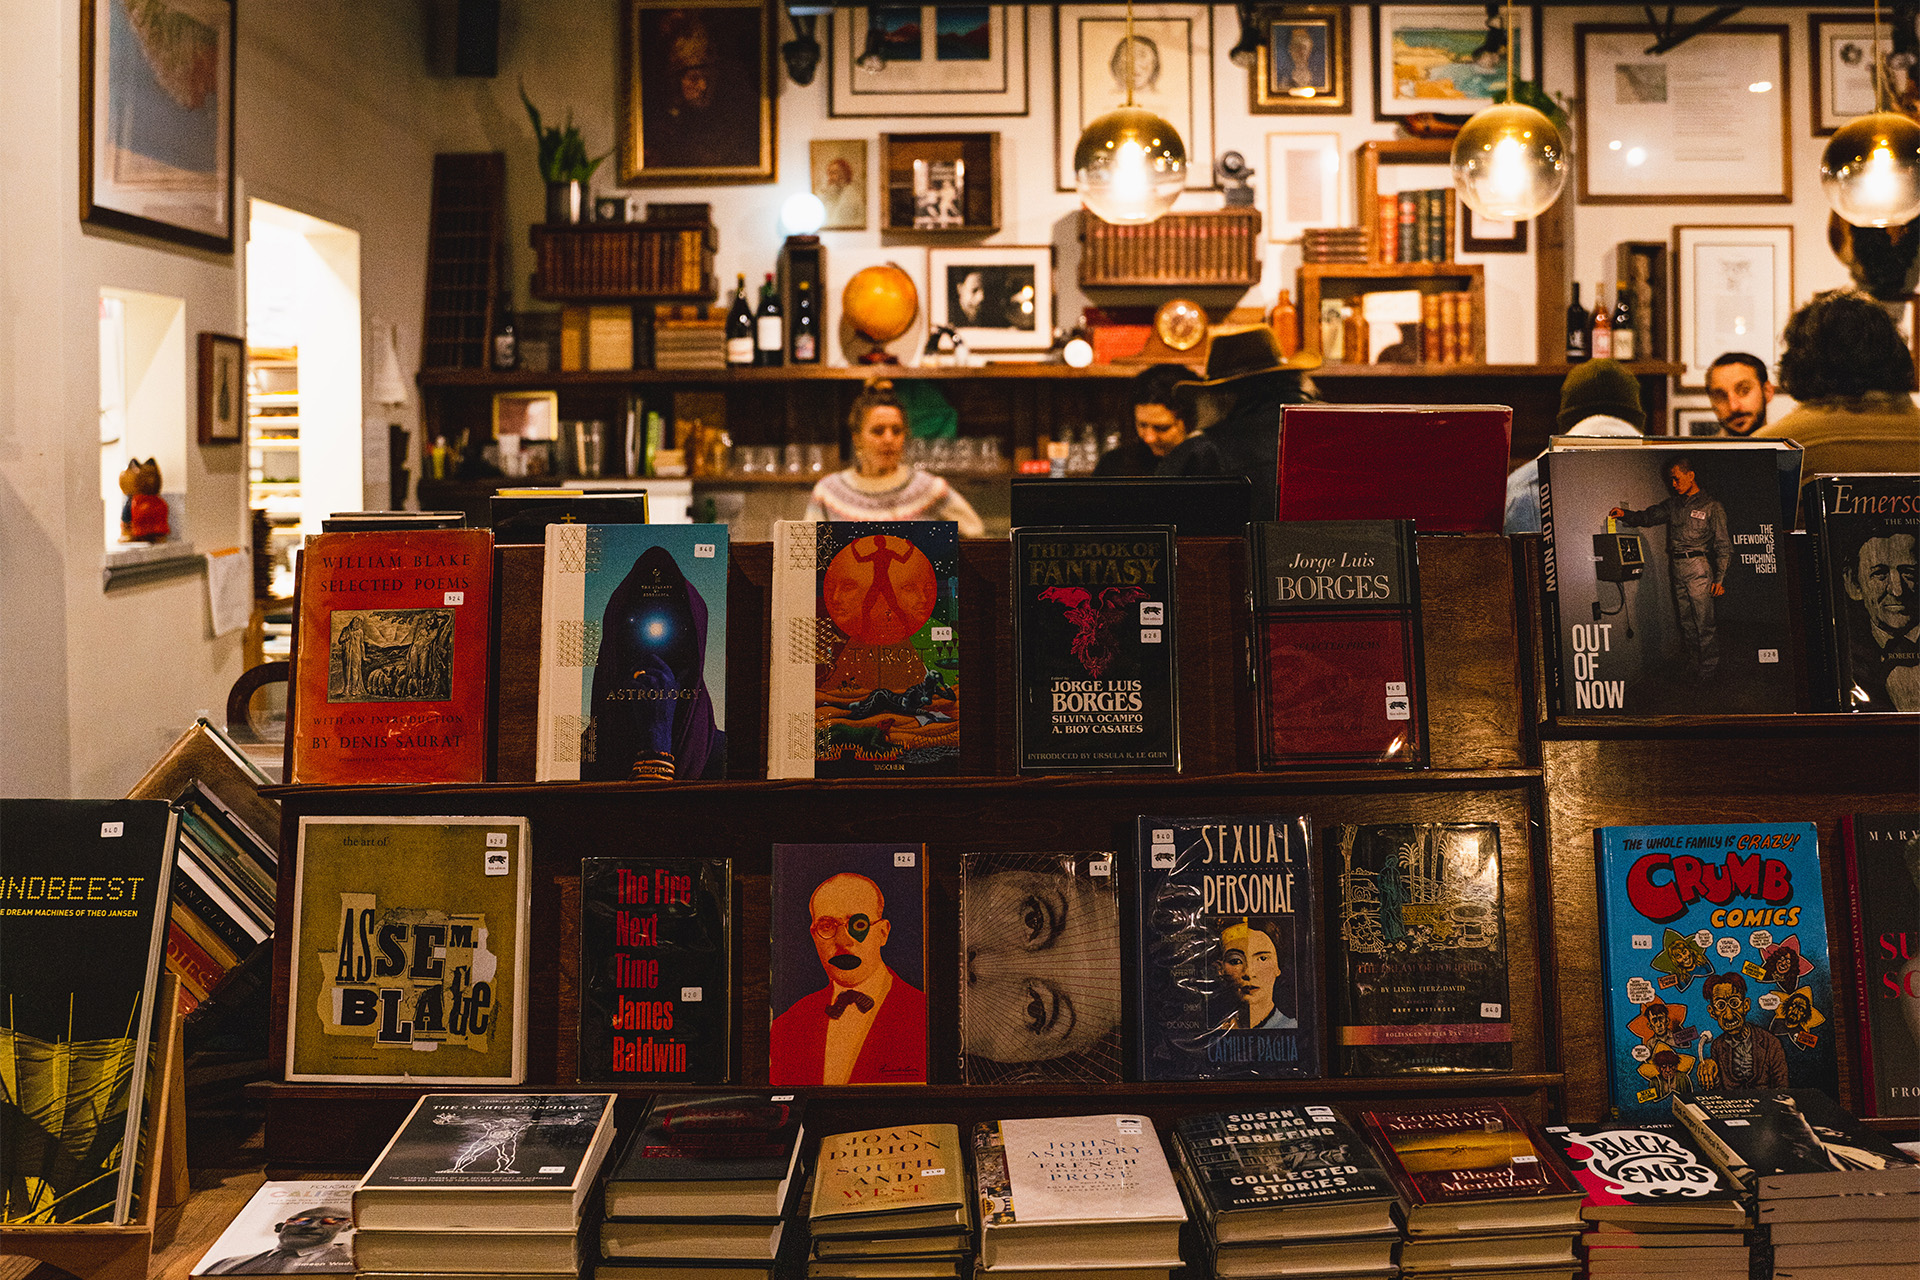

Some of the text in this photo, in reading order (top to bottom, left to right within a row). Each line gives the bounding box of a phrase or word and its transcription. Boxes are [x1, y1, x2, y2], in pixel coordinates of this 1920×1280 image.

[1538, 482, 1553, 519] OUT
[1540, 521, 1555, 545] OF
[1759, 524, 1773, 534] THE
[1733, 534, 1775, 545] LIFEWORKS
[1028, 542, 1161, 558] THE BOOK OF
[1765, 544, 1775, 554] OF
[322, 553, 471, 569] WILLIAM BLAKE
[1289, 552, 1375, 574] Jorge Luis
[1740, 554, 1776, 564] TEHCHING
[1028, 558, 1161, 586] FANTASY
[1543, 546, 1557, 593] NOW
[1755, 564, 1777, 574] HSIEH
[320, 577, 469, 592] SELECTED POEMS
[1275, 575, 1390, 600] BORGES
[1572, 624, 1612, 652] OUT
[1574, 652, 1599, 681] OF
[606, 689, 702, 700] ASTROLOGY
[1051, 680, 1142, 693] JORGE LUIS
[1575, 680, 1625, 709] NOW
[1051, 692, 1143, 713] BORGES
[313, 714, 463, 725] WITH AN INTRODUCTION
[1052, 713, 1143, 724] SILVINA OCAMPO
[1052, 724, 1144, 734] A. BIOY CASARES
[312, 735, 463, 749] BY DENIS SAURAT
[1028, 752, 1079, 760] INTRODUCED
[1093, 752, 1125, 760] URSULA
[1148, 751, 1168, 759] GUIN
[104, 826, 118, 834] $40
[343, 836, 389, 847] the art of
[1202, 824, 1293, 864] SEXUAL
[1623, 833, 1801, 852] THE WHOLE FAMILY IS CRAZY!
[617, 868, 691, 905] The Fire
[1626, 851, 1794, 924] CRUMB
[6, 908, 138, 917] DREAM MACHINES OF THEO JANSEN
[1710, 907, 1802, 928] COMICS
[616, 910, 659, 947] Next
[615, 953, 660, 989] Time
[1381, 985, 1390, 993] BY
[612, 995, 674, 1030] James
[612, 1036, 687, 1073] Baldwin
[1208, 1035, 1299, 1063] CAMILLE PAGLIA
[1228, 1110, 1295, 1123] SUSAN
[1389, 1117, 1503, 1131] McCARTHY
[1397, 1109, 1490, 1123] CORMAC
[1226, 1118, 1306, 1132] SONTAG
[846, 1130, 923, 1146] JOAN
[1049, 1138, 1117, 1150] JOHN
[1210, 1127, 1335, 1147] DEBRIEFING
[830, 1140, 941, 1160] DIDION
[1027, 1147, 1143, 1159] ASHBERY
[1587, 1134, 1688, 1162] BLACK
[836, 1158, 932, 1176] SOUTH
[1040, 1159, 1136, 1169] FRENCH
[1593, 1154, 1710, 1184] VENUS
[854, 1173, 914, 1186] AND
[1051, 1170, 1134, 1181] PROSE
[1230, 1165, 1358, 1186] COLLECTED
[1451, 1167, 1516, 1181] Blood
[843, 1184, 925, 1198] WEST
[1253, 1177, 1348, 1195] STORIES
[1287, 1189, 1337, 1199] BENJAMIN
[1340, 1185, 1376, 1193] TAYLOR
[1441, 1176, 1541, 1193] Meridian
